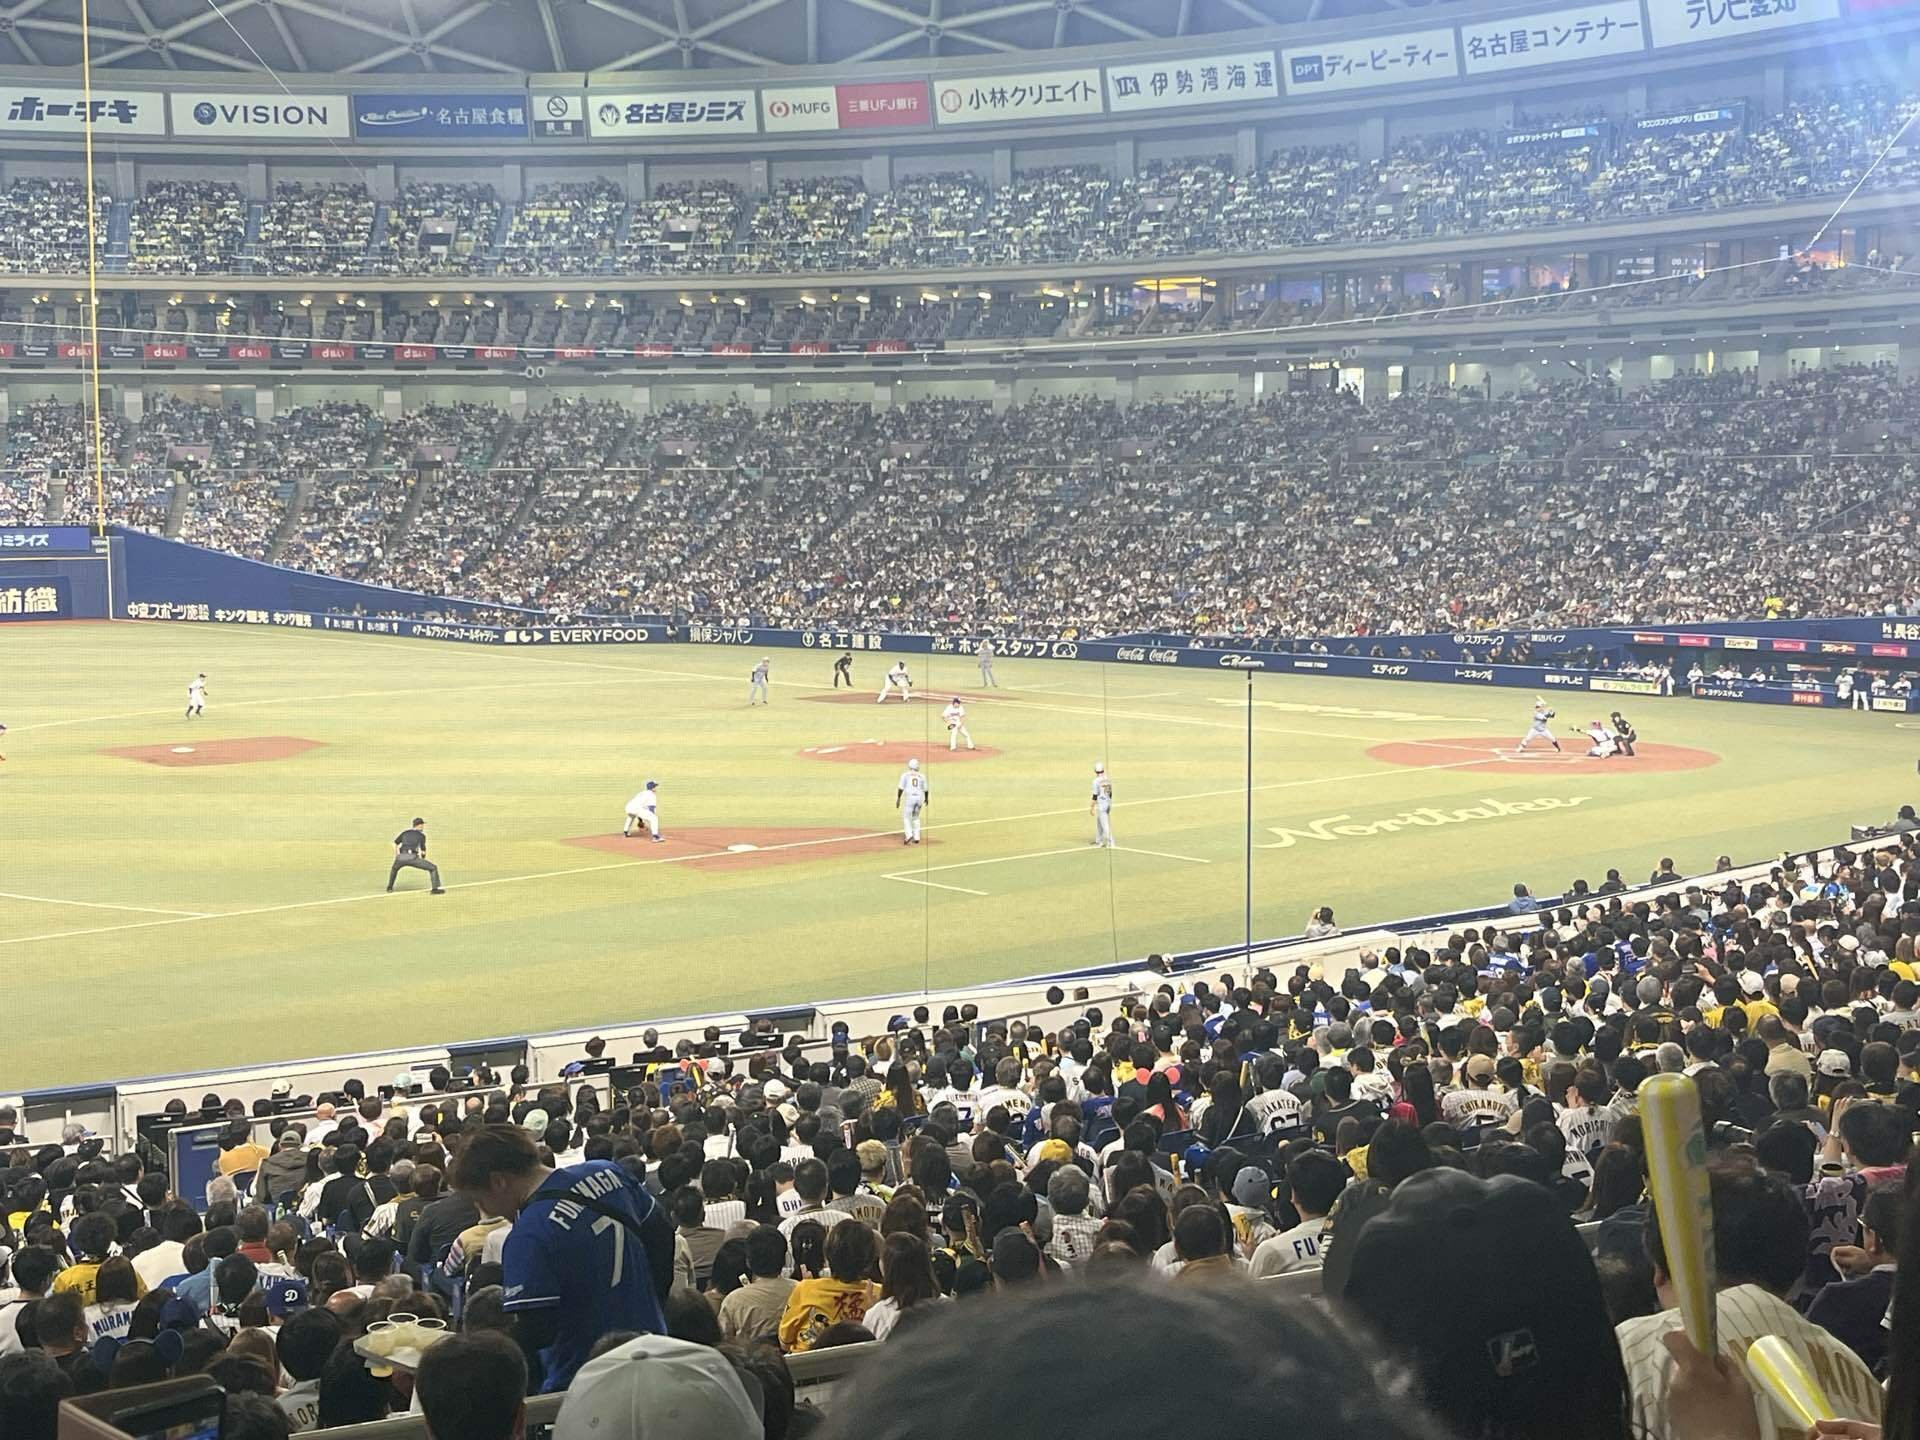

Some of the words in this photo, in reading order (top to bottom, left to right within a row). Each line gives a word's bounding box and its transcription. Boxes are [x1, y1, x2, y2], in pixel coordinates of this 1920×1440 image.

[1467, 17, 1639, 59] 名古屋コンテナー
[1295, 63, 1320, 77] DPT
[1324, 45, 1449, 77] ディーピーティー
[1151, 61, 1274, 97] 伊勢湾海運
[968, 80, 1098, 110] 小林クリエイト
[7, 96, 138, 124] ホーチキ
[222, 104, 328, 125] VISION
[625, 101, 746, 124] 名古屋シミズ
[792, 101, 831, 115] MUFG
[848, 98, 918, 112] 三菱UFJ銀行
[0, 534, 49, 547] ミライズ
[550, 629, 649, 642] EVERYFOOD
[689, 627, 753, 644] 損保ジャパン
[1893, 622, 1920, 641] 長谷
[819, 633, 883, 650] 名工建設
[958, 638, 1048, 657] ホッスタッフ
[1372, 664, 1409, 675] エディオン
[1252, 796, 1593, 849] Noritake
[591, 1215, 625, 1288] 7
[283, 1288, 299, 1303] D
